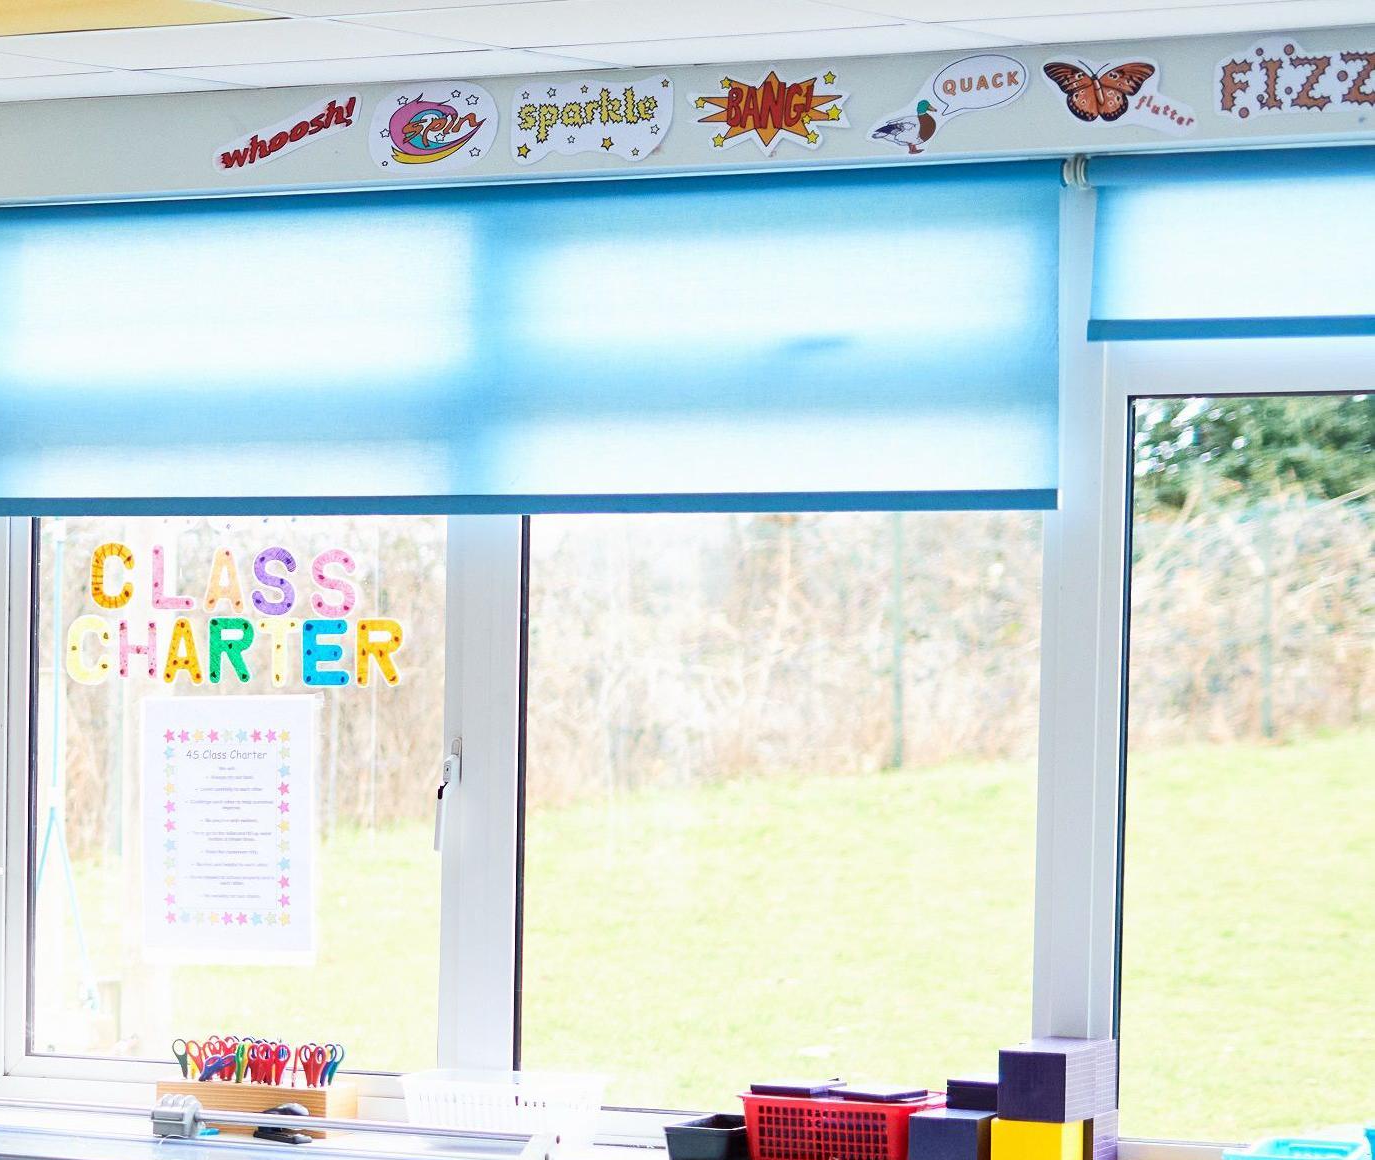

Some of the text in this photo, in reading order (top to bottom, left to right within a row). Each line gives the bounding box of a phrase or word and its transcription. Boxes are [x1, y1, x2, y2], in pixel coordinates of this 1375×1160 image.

[727, 78, 814, 130] BANG!
[942, 71, 1020, 96] QUACK
[220, 96, 357, 169] whoosh!
[402, 111, 486, 148] spin
[517, 86, 658, 143] sparkle
[1135, 94, 1195, 128] flutter
[90, 542, 356, 617] CLASS
[66, 615, 403, 688] CHARTER
[202, 749, 227, 760] Class
[229, 749, 268, 760] Charter
